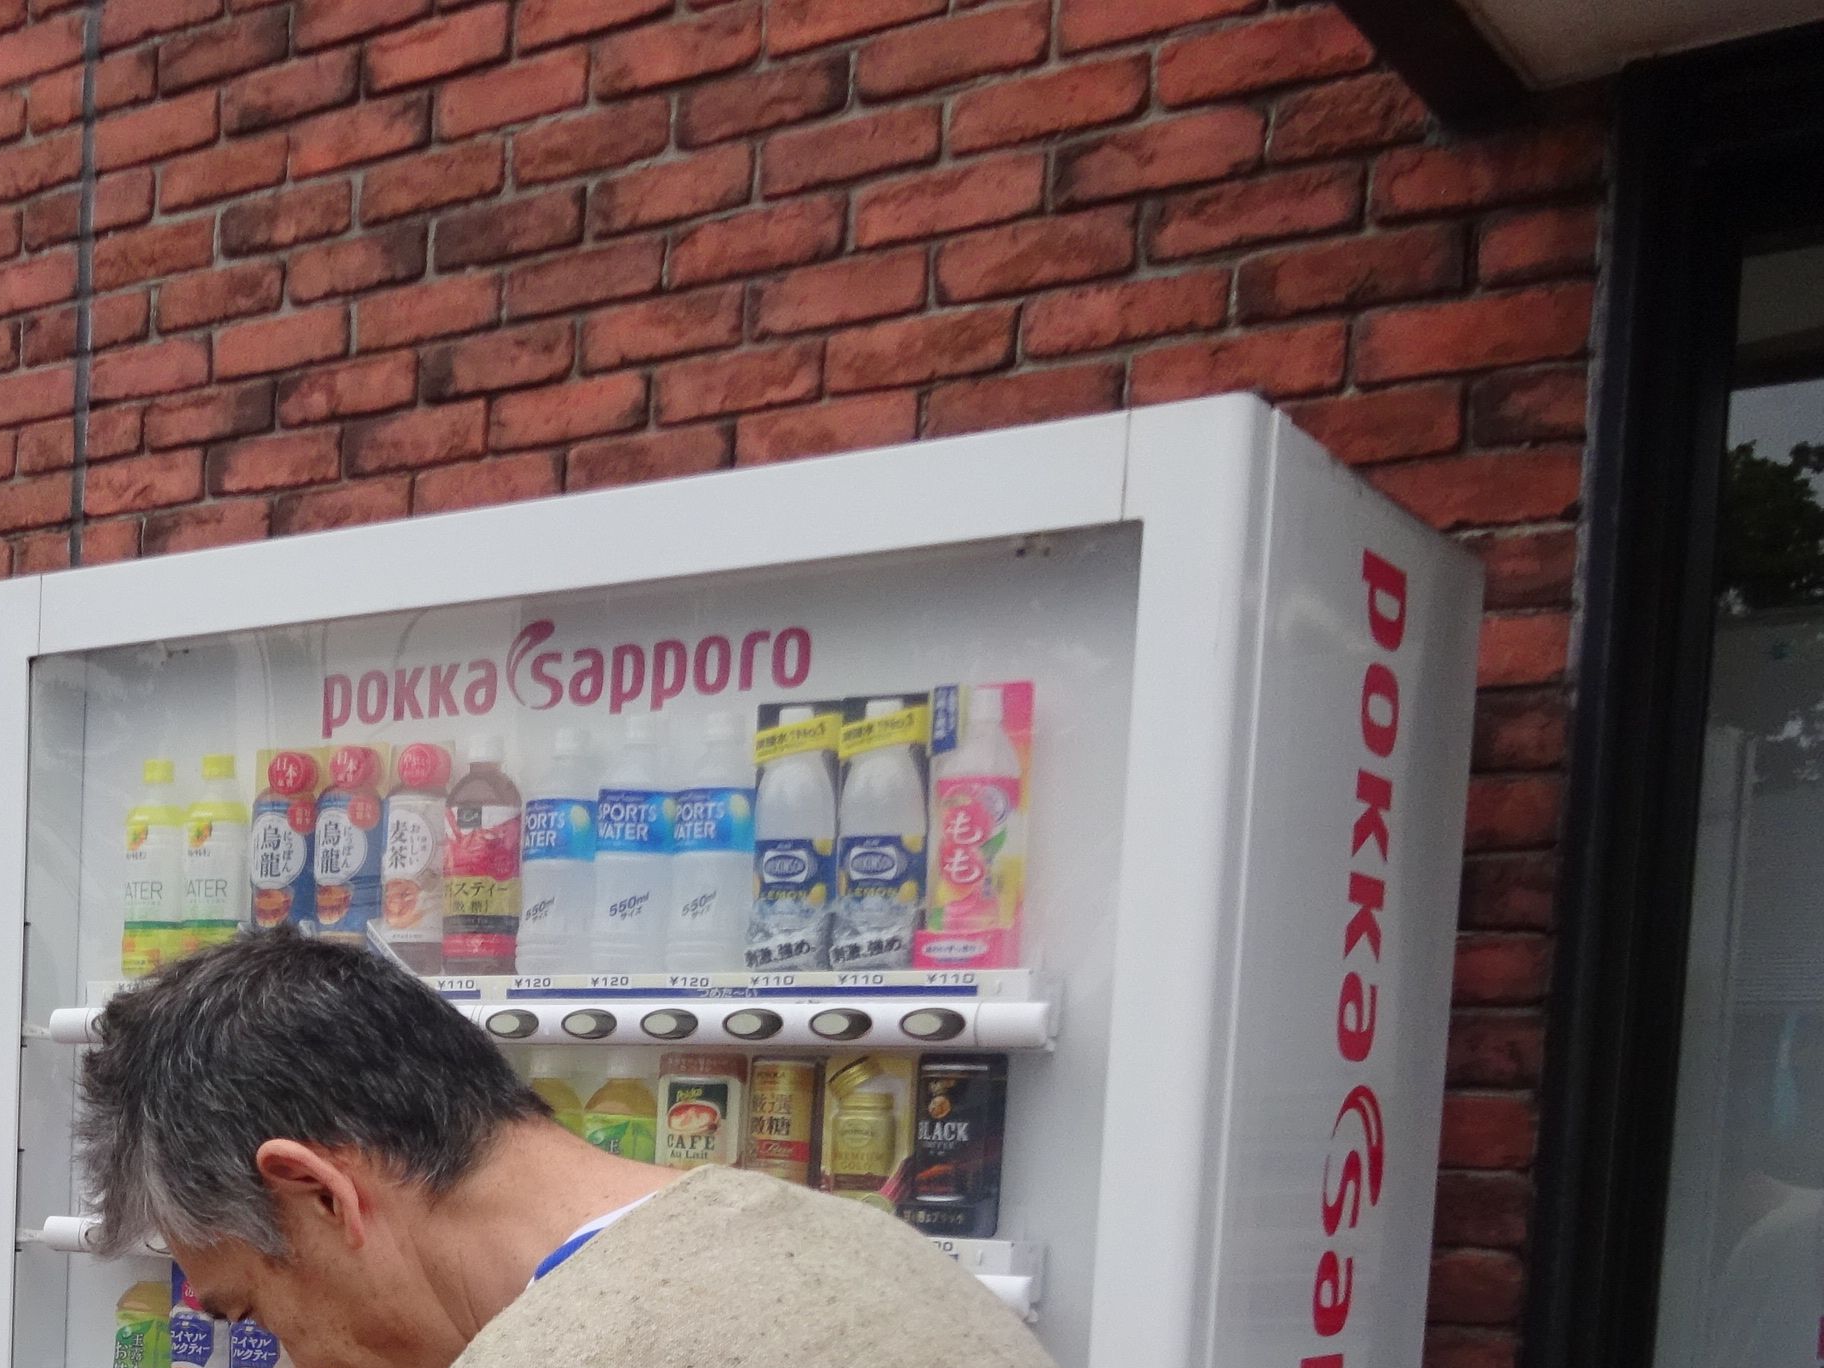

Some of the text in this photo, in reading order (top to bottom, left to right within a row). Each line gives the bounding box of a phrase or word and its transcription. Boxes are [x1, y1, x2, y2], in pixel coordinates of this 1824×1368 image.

[389, 819, 407, 868] 麦茶
[944, 810, 981, 885] もも
[609, 891, 649, 916] 550ml
[438, 979, 474, 989] ¥110
[515, 978, 551, 988] ¥120
[591, 976, 629, 986] ¥120
[670, 977, 709, 987] ¥120
[750, 975, 794, 986] ¥110
[837, 974, 883, 985] ¥110
[927, 973, 975, 985] ¥110
[667, 1134, 715, 1150] CAFE
